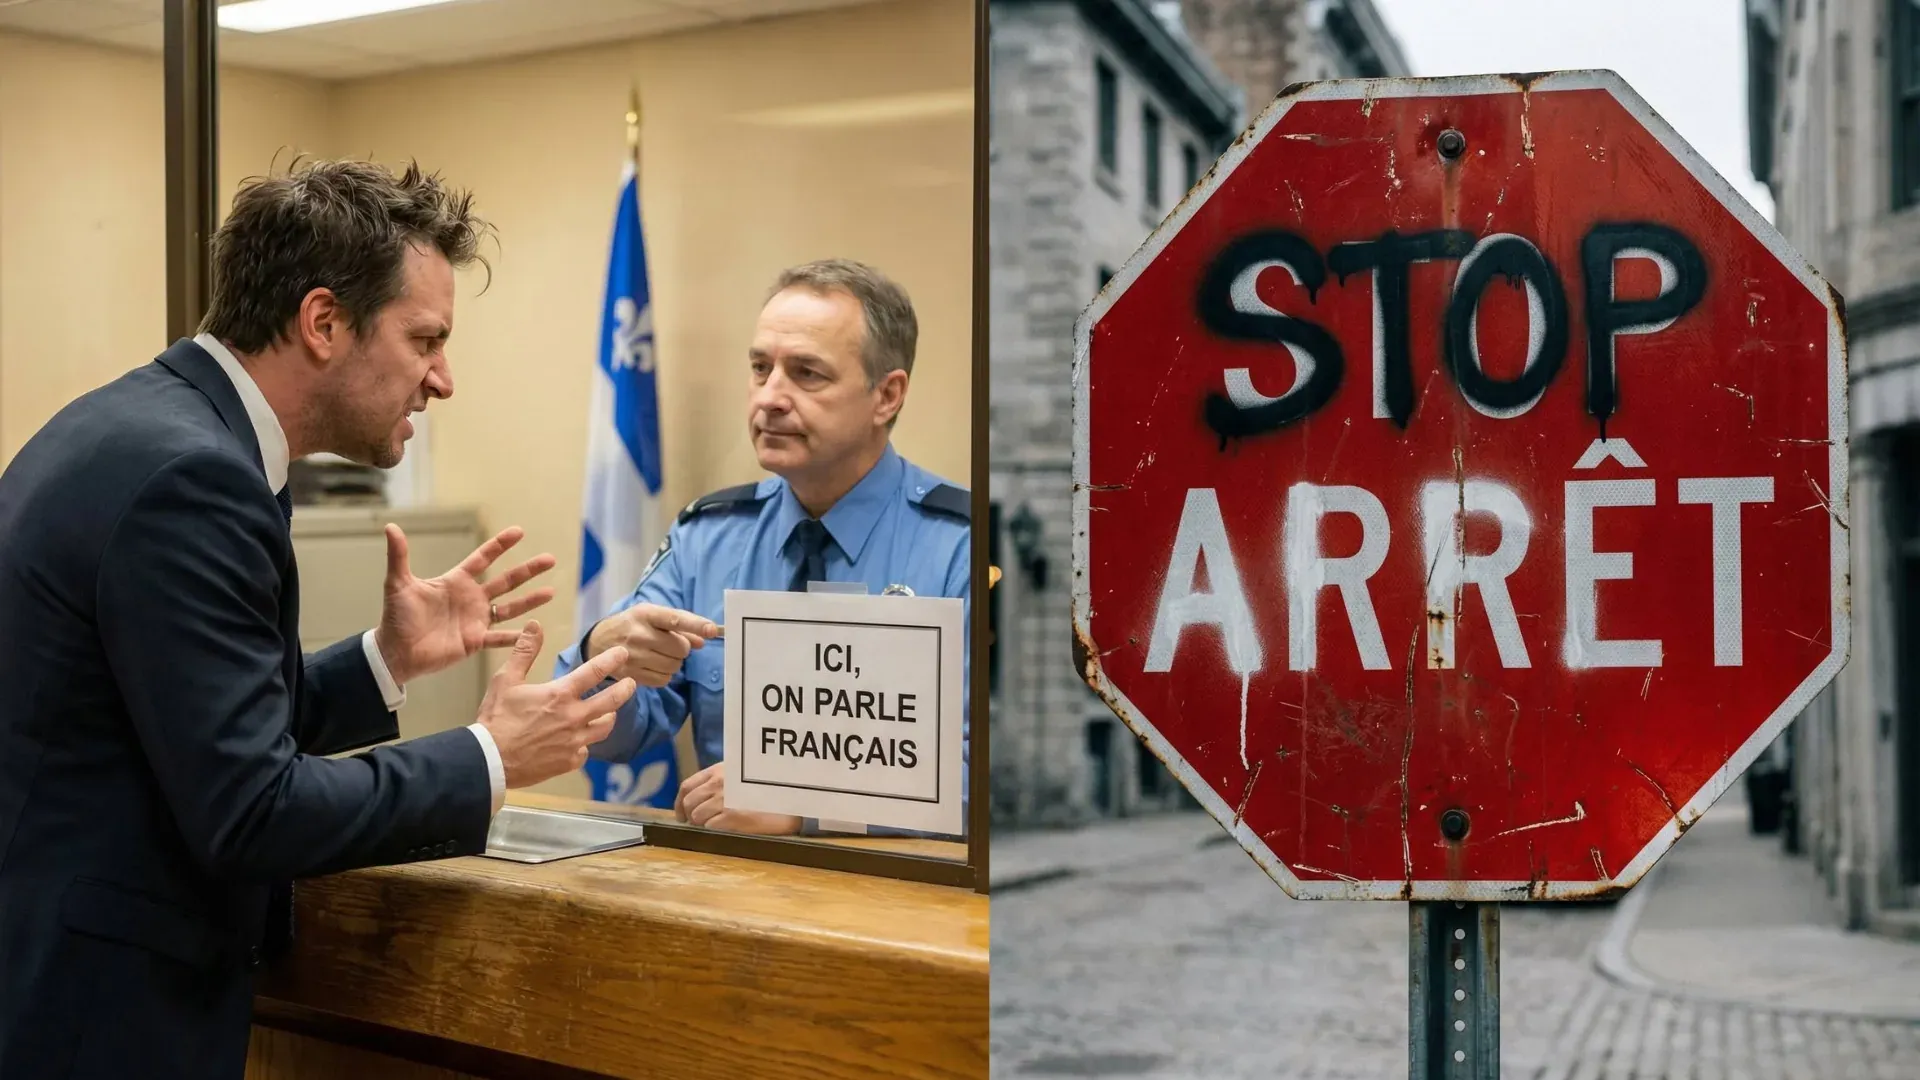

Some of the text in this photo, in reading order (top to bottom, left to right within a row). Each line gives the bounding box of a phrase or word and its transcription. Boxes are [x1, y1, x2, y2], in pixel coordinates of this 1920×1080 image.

[1200, 221, 1708, 440] STOP
[1143, 437, 1775, 673] ARRÊT
[815, 643, 860, 679] ICI,
[761, 684, 917, 723] ON PARLE
[761, 727, 918, 770] FRANÇAIS
